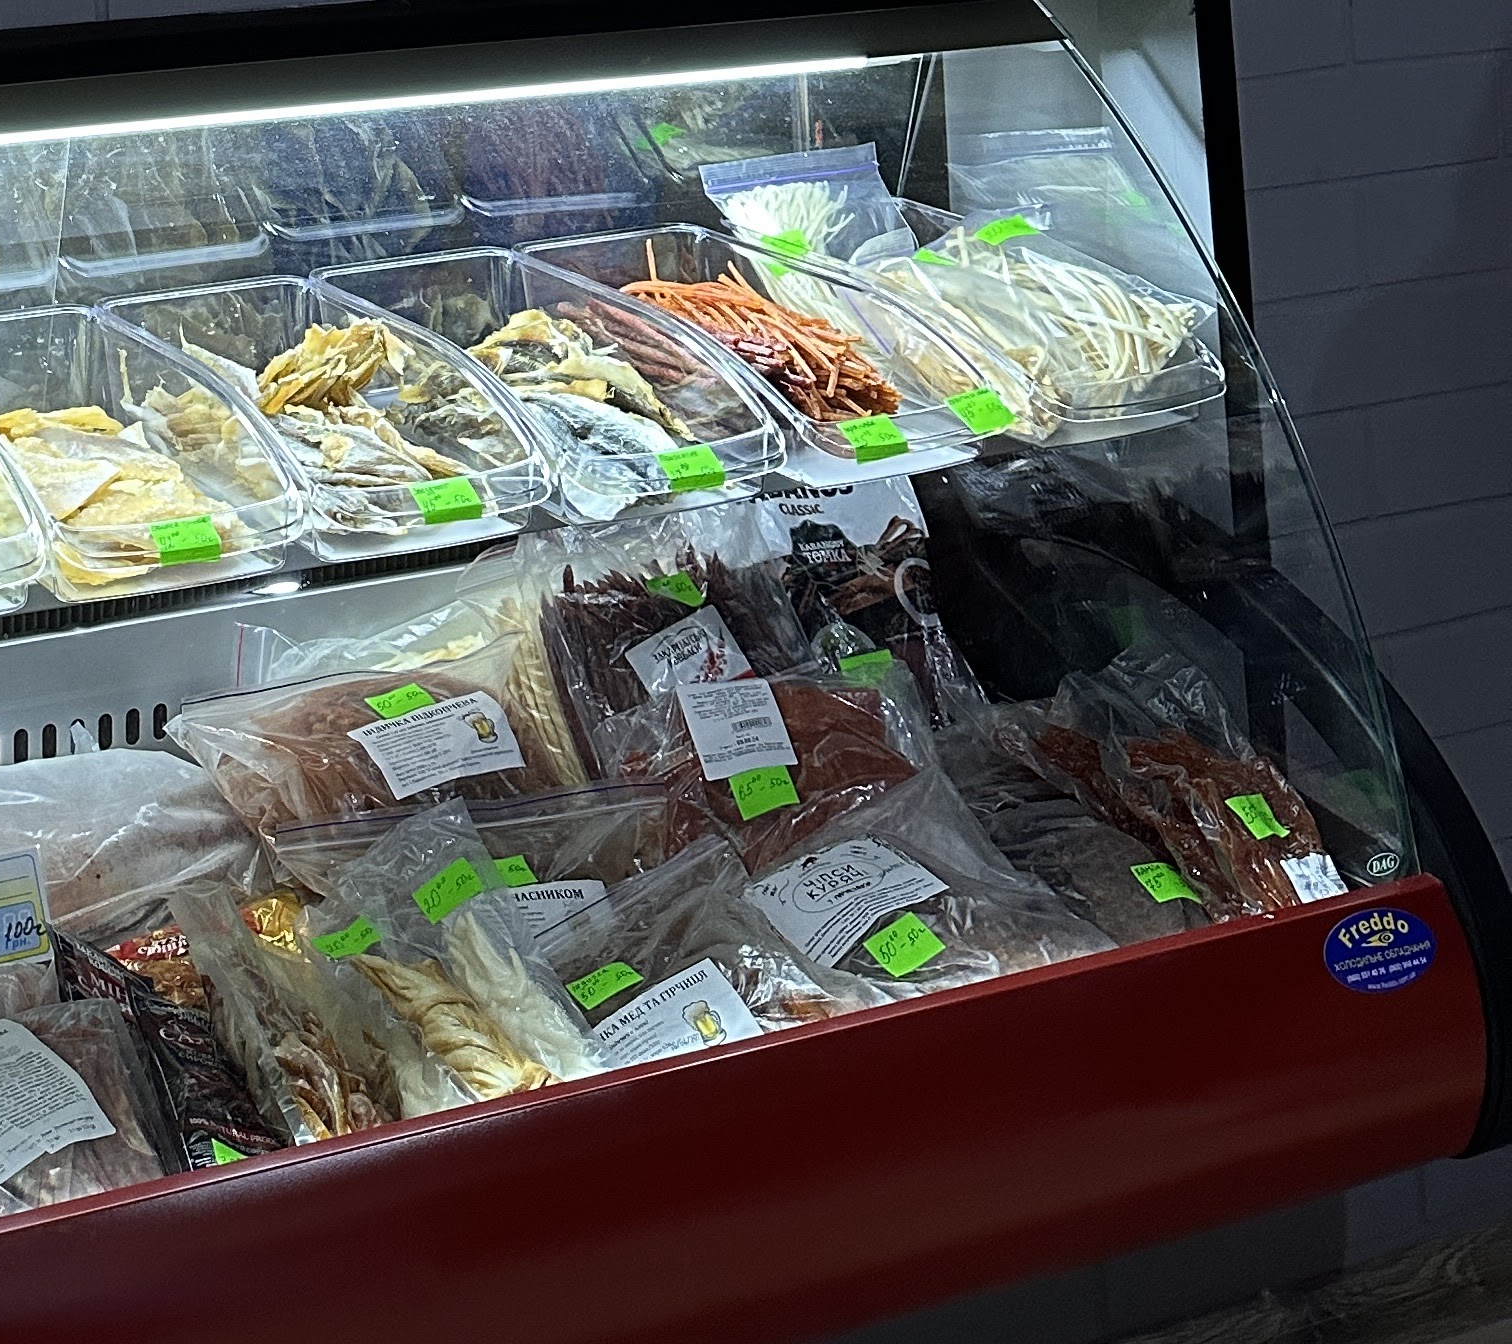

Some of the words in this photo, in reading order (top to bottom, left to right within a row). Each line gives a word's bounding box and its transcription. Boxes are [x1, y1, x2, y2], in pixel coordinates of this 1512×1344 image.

[779, 503, 825, 516] CLASSIC
[1372, 855, 1396, 872] DAG
[803, 864, 855, 889] ЧІПСИ
[1338, 912, 1409, 949] Freddo
[619, 1006, 645, 1026] МЕД
[642, 997, 661, 1010] ТА
[660, 970, 708, 1001] ГІРЧИЦЯ
